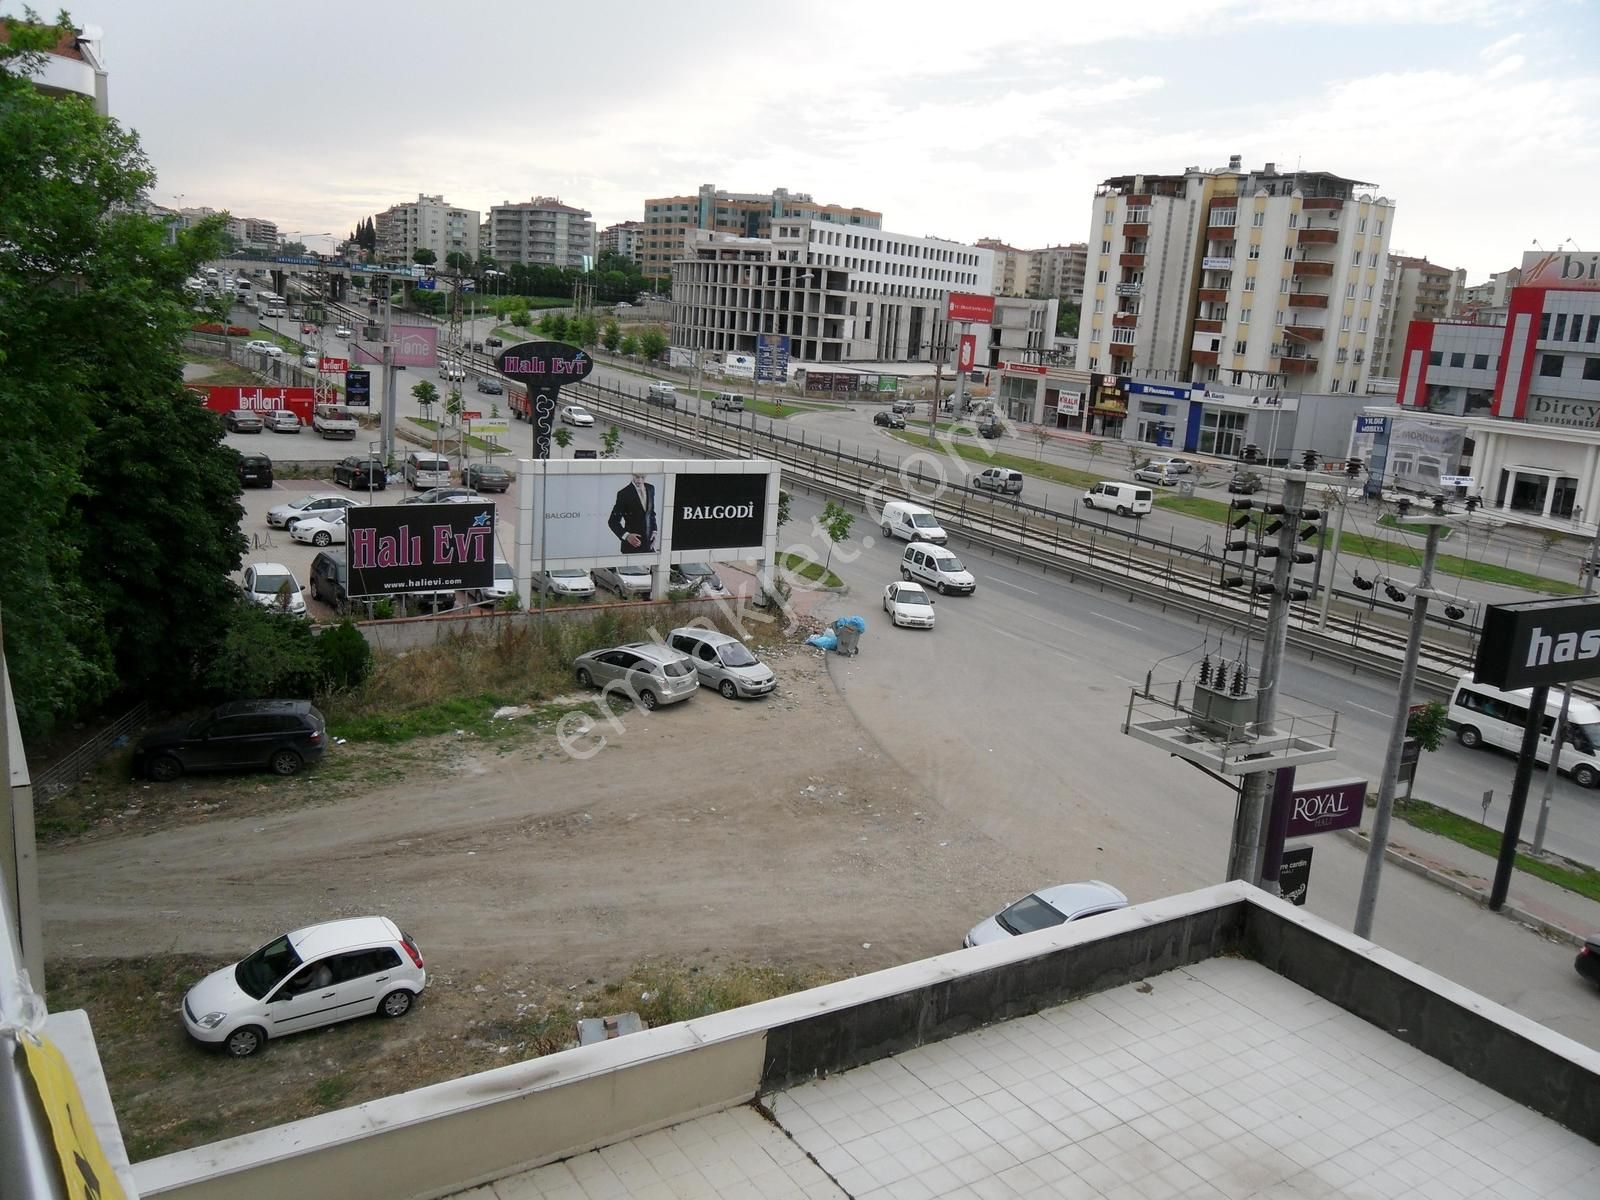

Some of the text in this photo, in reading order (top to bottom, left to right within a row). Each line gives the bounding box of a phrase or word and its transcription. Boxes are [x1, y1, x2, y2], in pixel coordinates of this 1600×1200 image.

[239, 388, 285, 410] brillant
[1535, 398, 1600, 420] birey
[683, 501, 754, 520] BALGODİ
[352, 524, 422, 569] Halı
[383, 577, 462, 589] www.halievi.com
[1292, 792, 1349, 821] ROYAL
